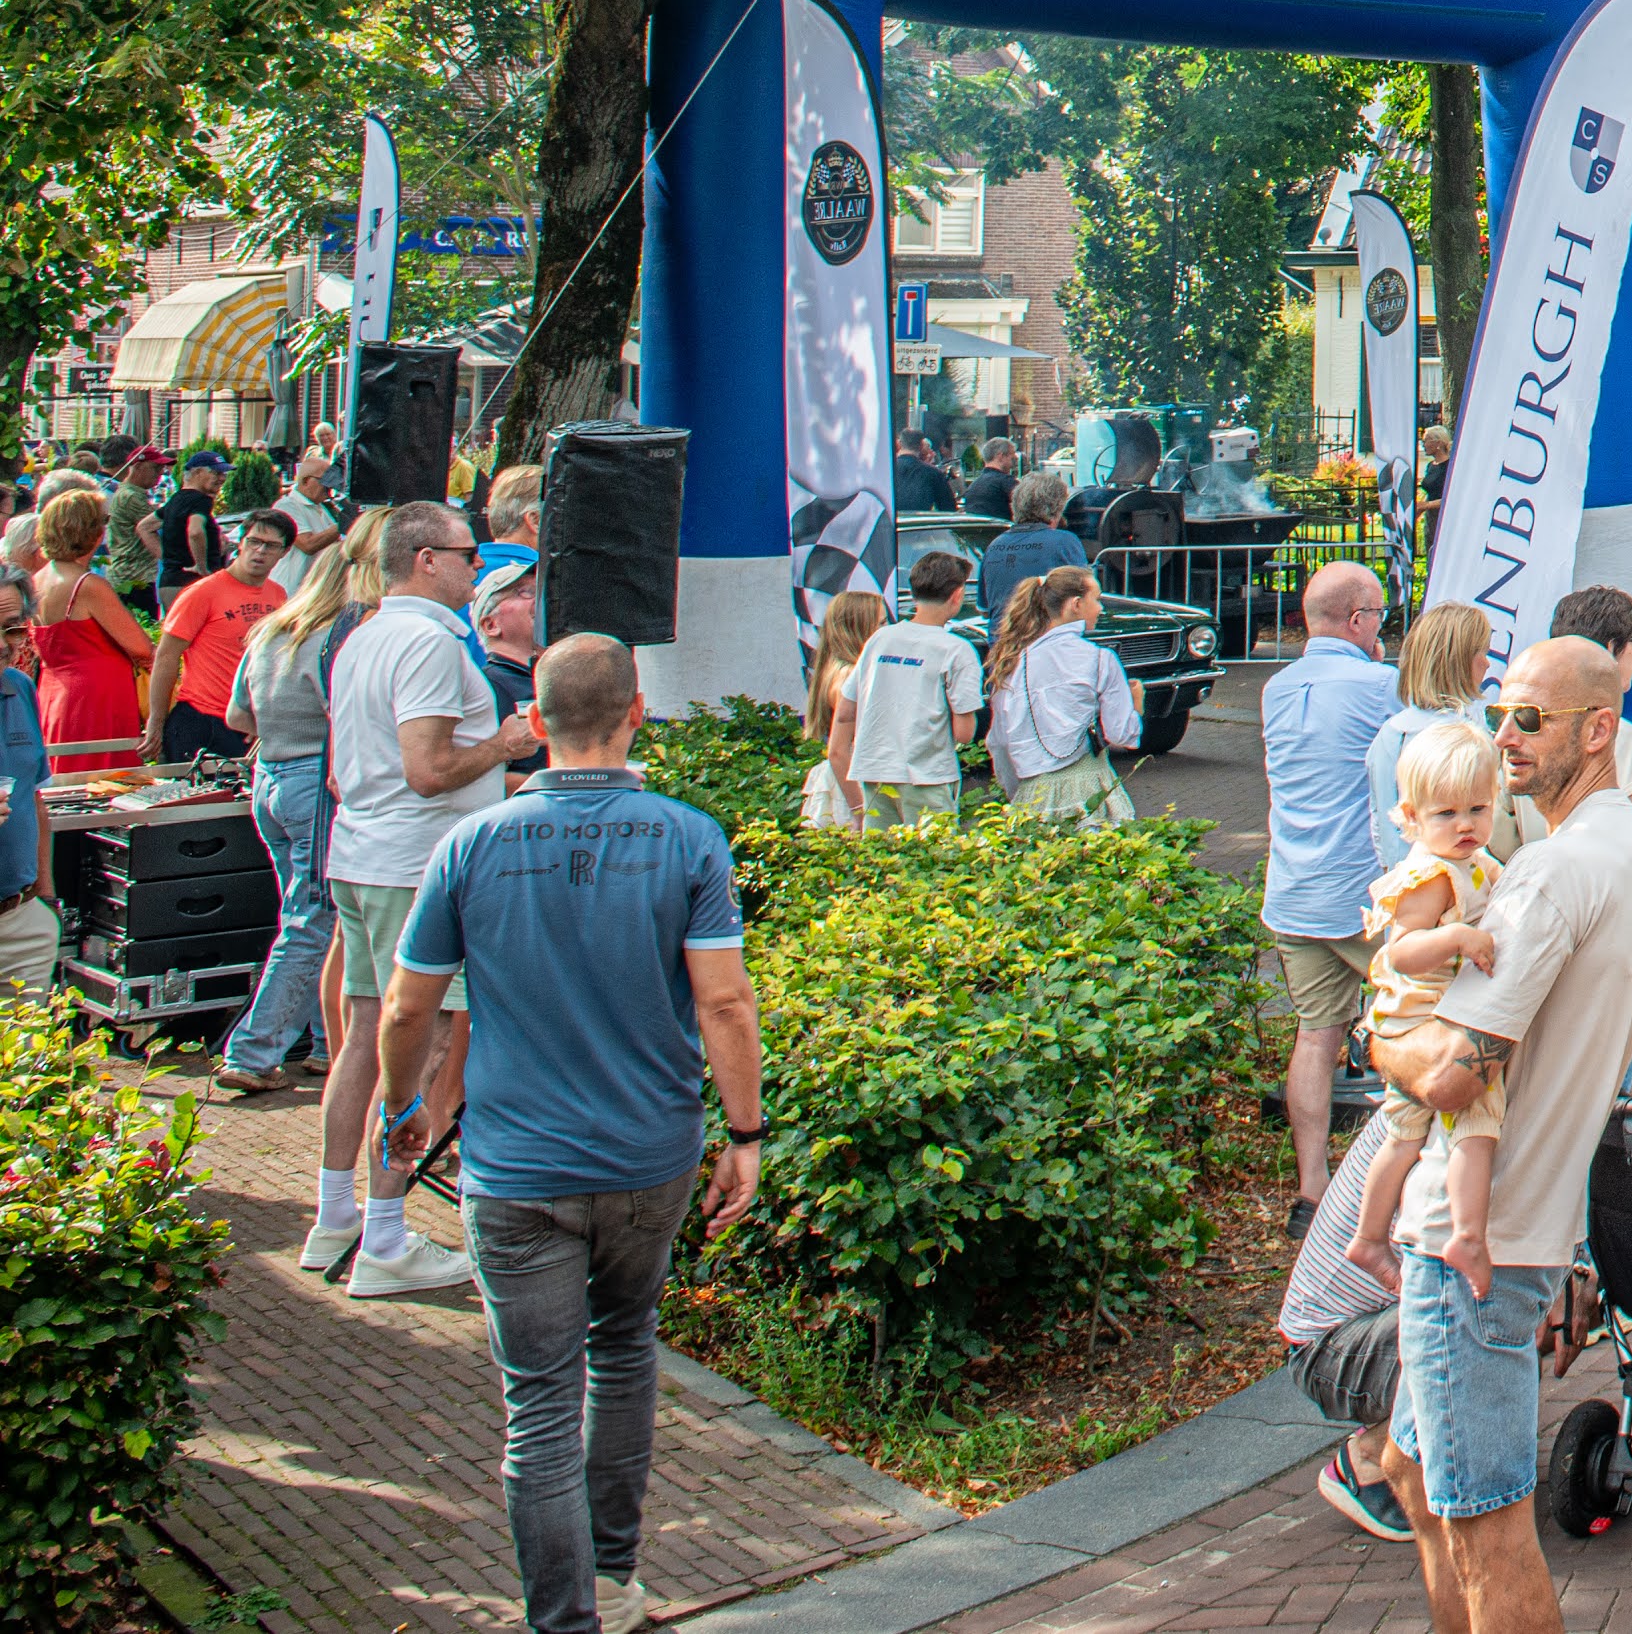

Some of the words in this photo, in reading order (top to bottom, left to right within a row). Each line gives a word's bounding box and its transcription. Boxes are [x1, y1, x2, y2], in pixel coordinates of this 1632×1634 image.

[1473, 221, 1596, 694] ENBURGH
[497, 823, 555, 843] CITO
[563, 821, 665, 840] MOTORS
